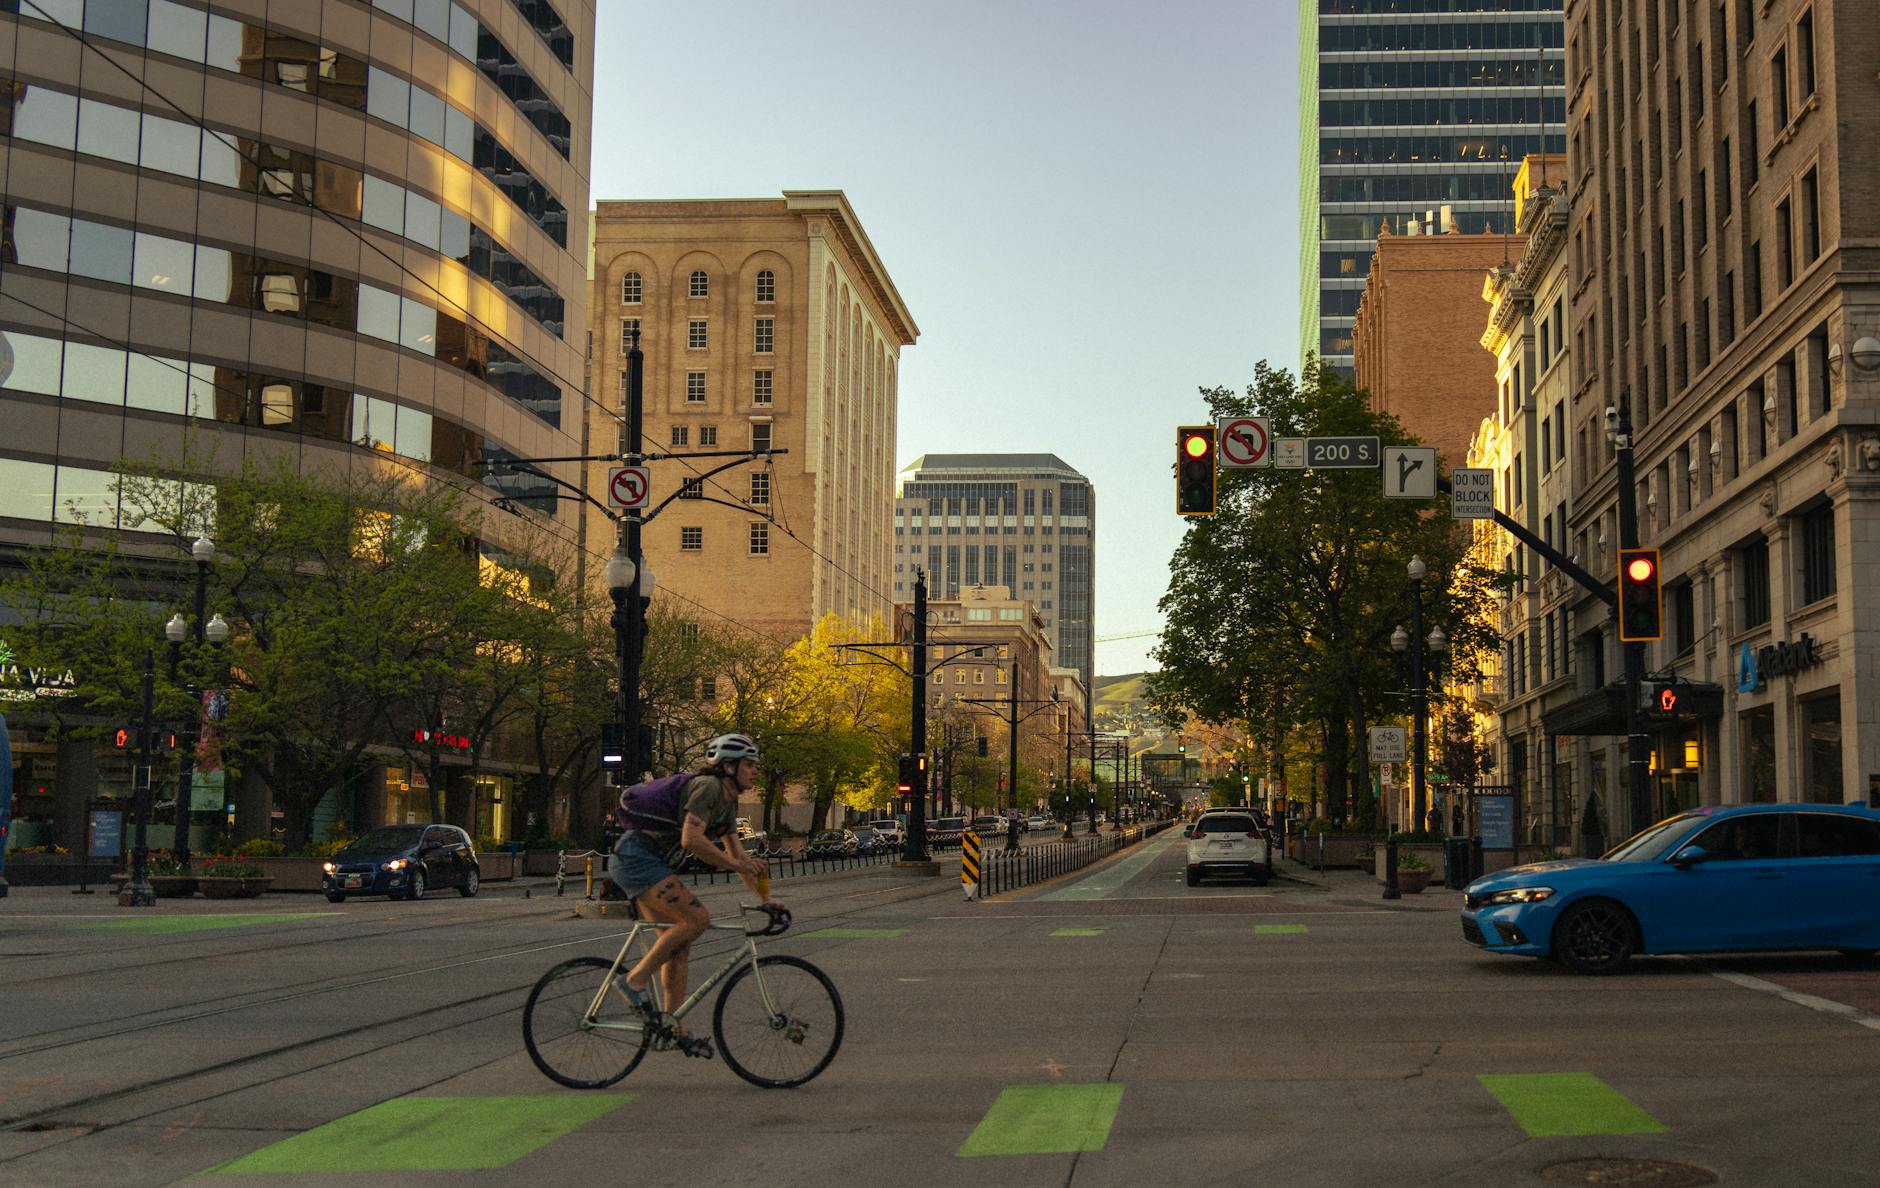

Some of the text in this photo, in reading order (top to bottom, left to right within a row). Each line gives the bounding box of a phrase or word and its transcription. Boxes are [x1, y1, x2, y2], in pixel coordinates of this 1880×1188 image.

[1314, 444, 1372, 461] 200 S.
[1455, 474, 1490, 486] DO NOT
[1455, 490, 1490, 502] BLOCK
[1455, 505, 1491, 514] INTERSECTION
